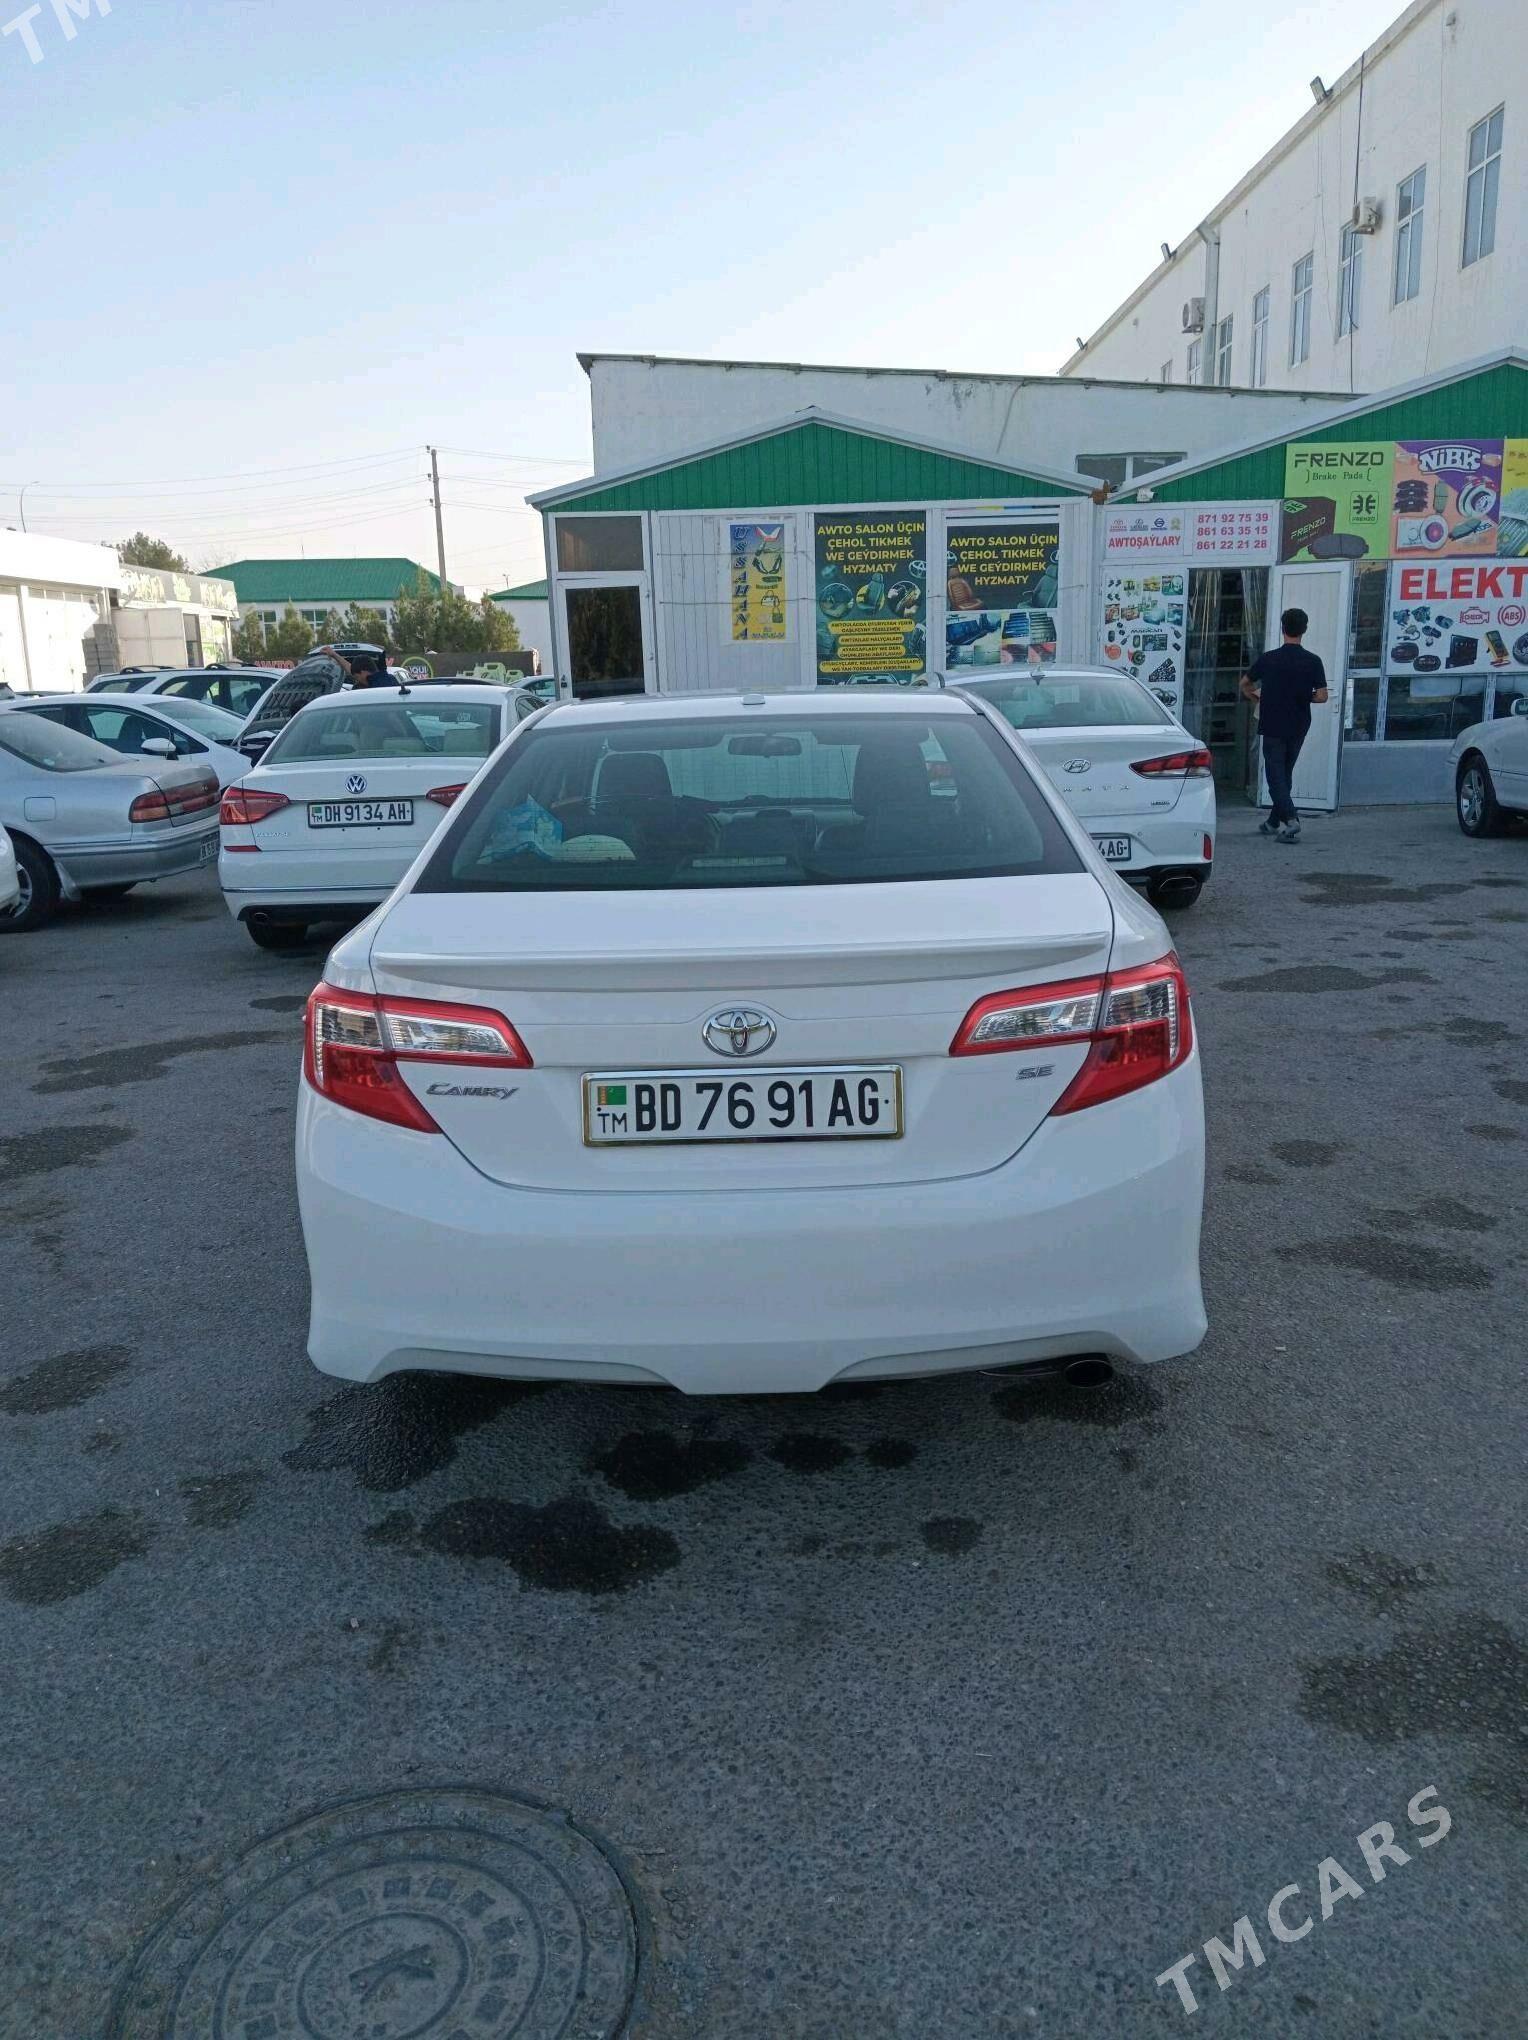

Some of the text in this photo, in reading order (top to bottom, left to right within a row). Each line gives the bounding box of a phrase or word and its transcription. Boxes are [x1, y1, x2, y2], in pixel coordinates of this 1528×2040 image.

[1294, 451, 1384, 468] FRENZO
[1312, 471, 1363, 480] Brake Pads
[1198, 513, 1269, 523] 871 92 75 39
[818, 521, 924, 535] AWTO SALON ÜÇIN
[1197, 525, 1267, 536] 861 63 35 15
[1290, 516, 1326, 540] FRENZO
[828, 537, 912, 550] ÇEHOL TIKMEK
[950, 533, 1057, 547] AWTO SALON ÜÇIN
[1108, 533, 1181, 549] AWTOŞAÝLARY
[1197, 539, 1267, 550] 861 22 21 28
[826, 549, 914, 561] WE GEÝDIRMEK
[960, 549, 1045, 562] ÇEHOL TIKMEK
[843, 563, 897, 574] HYZMATY
[958, 561, 1046, 573] WE GEÝDIRMEK
[975, 575, 1029, 585] HYZMATY
[1400, 566, 1528, 600] ELEKT
[1504, 611, 1519, 621] ABS
[325, 805, 341, 822] DH
[388, 802, 406, 820] AH
[312, 815, 323, 823] TM
[634, 1083, 682, 1132] BD
[828, 1077, 880, 1126] AG
[598, 1112, 628, 1134] TM
